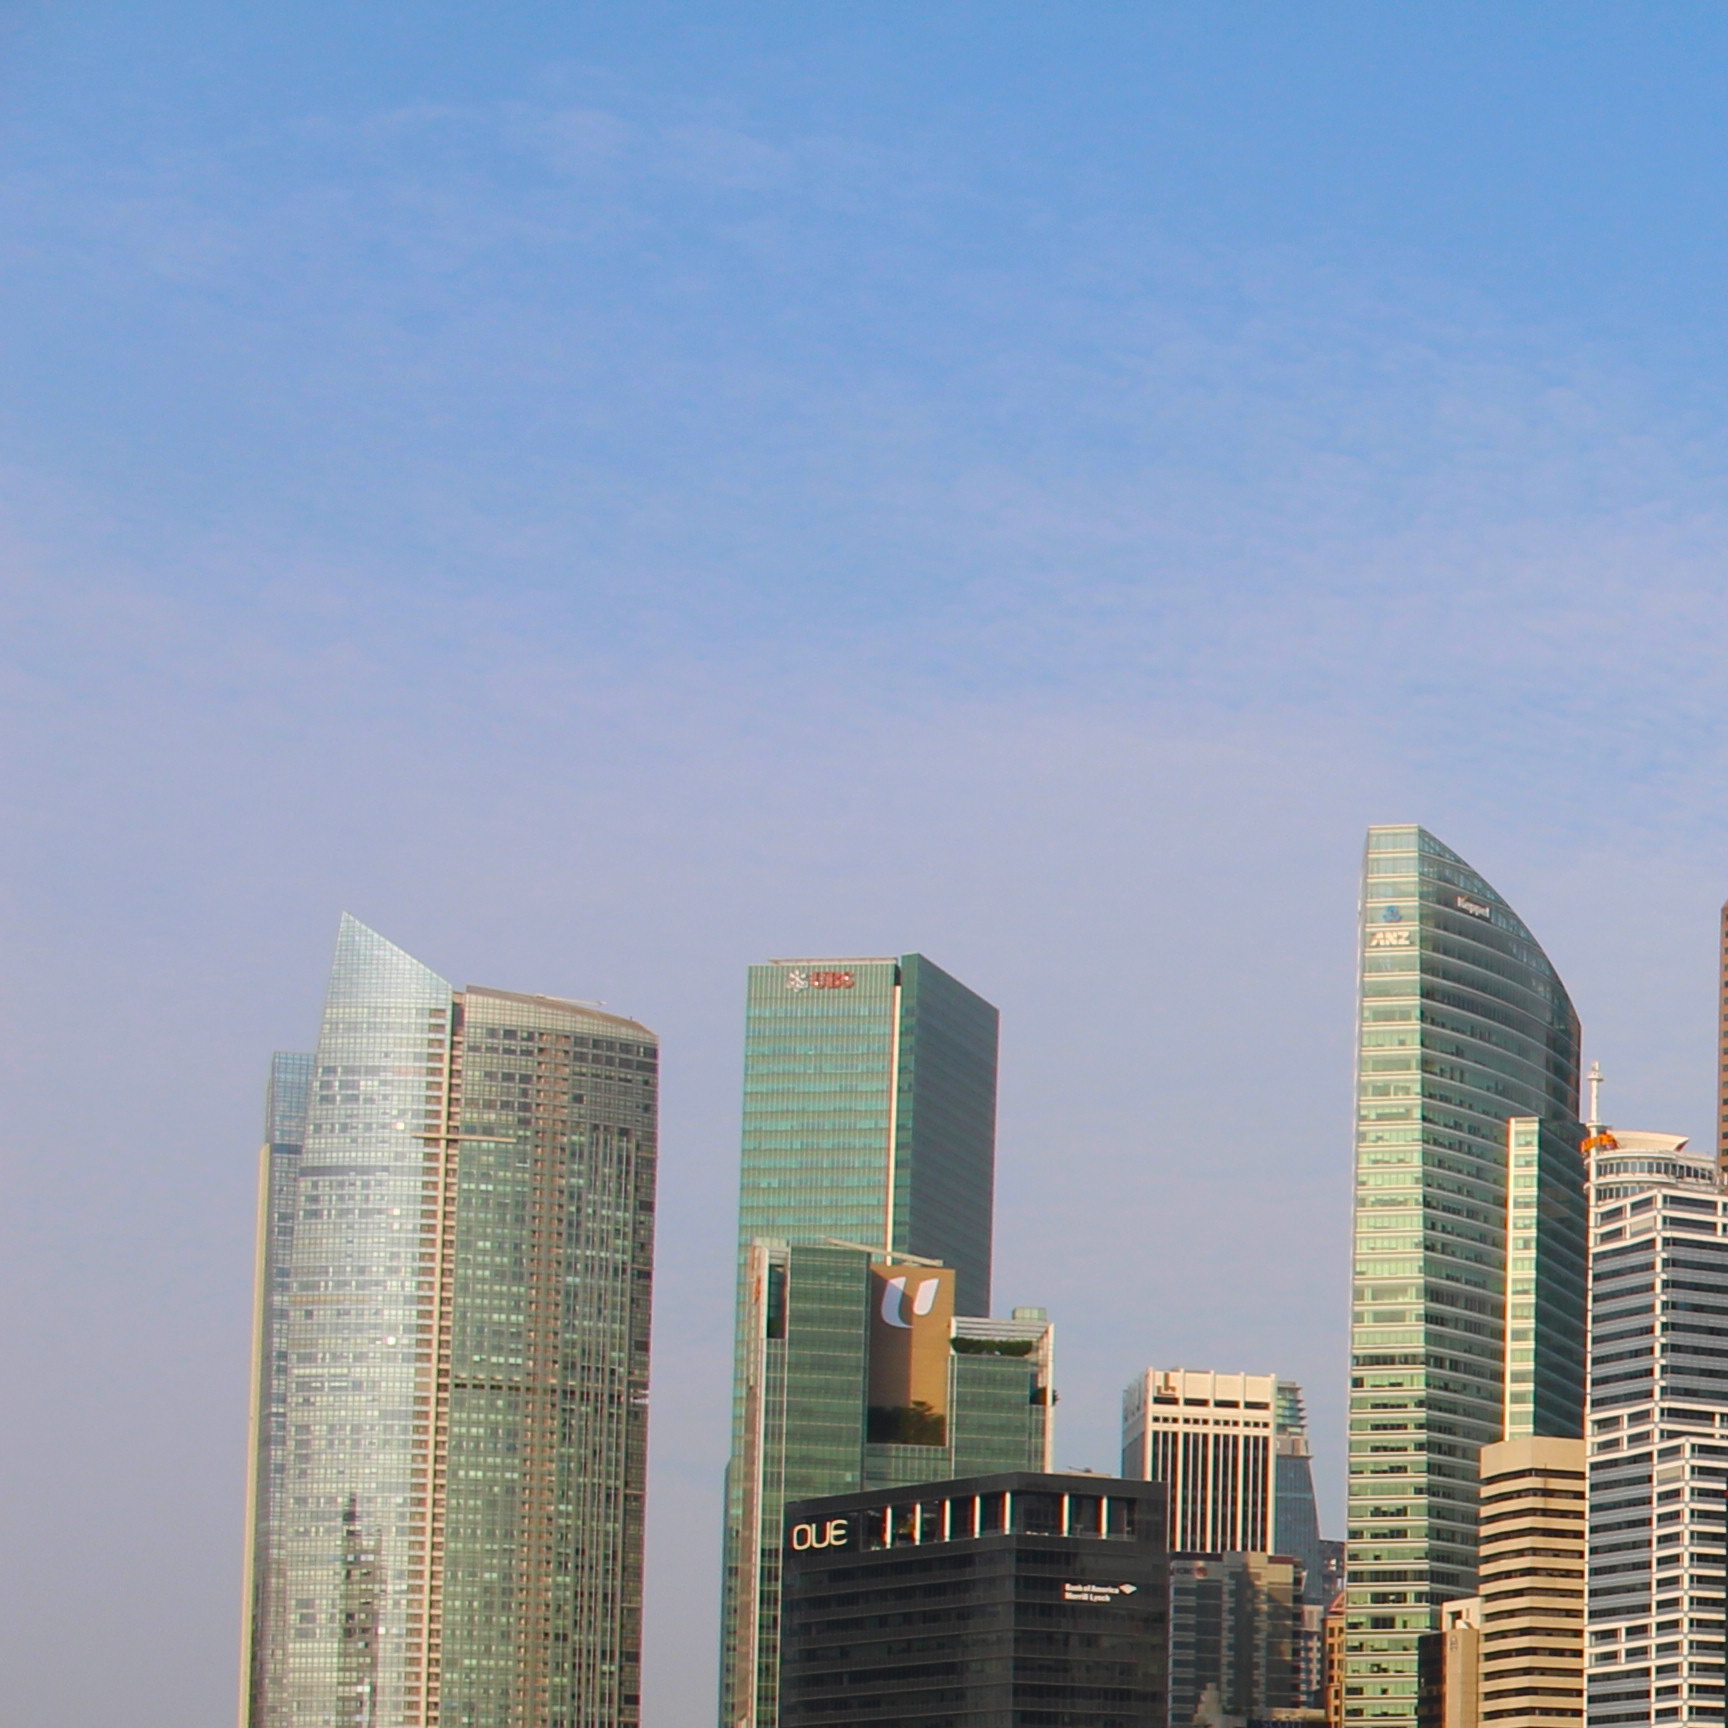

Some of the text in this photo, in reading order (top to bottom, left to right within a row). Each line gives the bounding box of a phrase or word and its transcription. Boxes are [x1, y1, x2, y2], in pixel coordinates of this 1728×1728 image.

[1457, 896, 1490, 918] Keppel
[1370, 931, 1411, 946] ANZ
[811, 971, 854, 989] UBS
[792, 1519, 848, 1550] OUE
[1064, 1583, 1082, 1592] Bank
[1092, 1585, 1120, 1594] America
